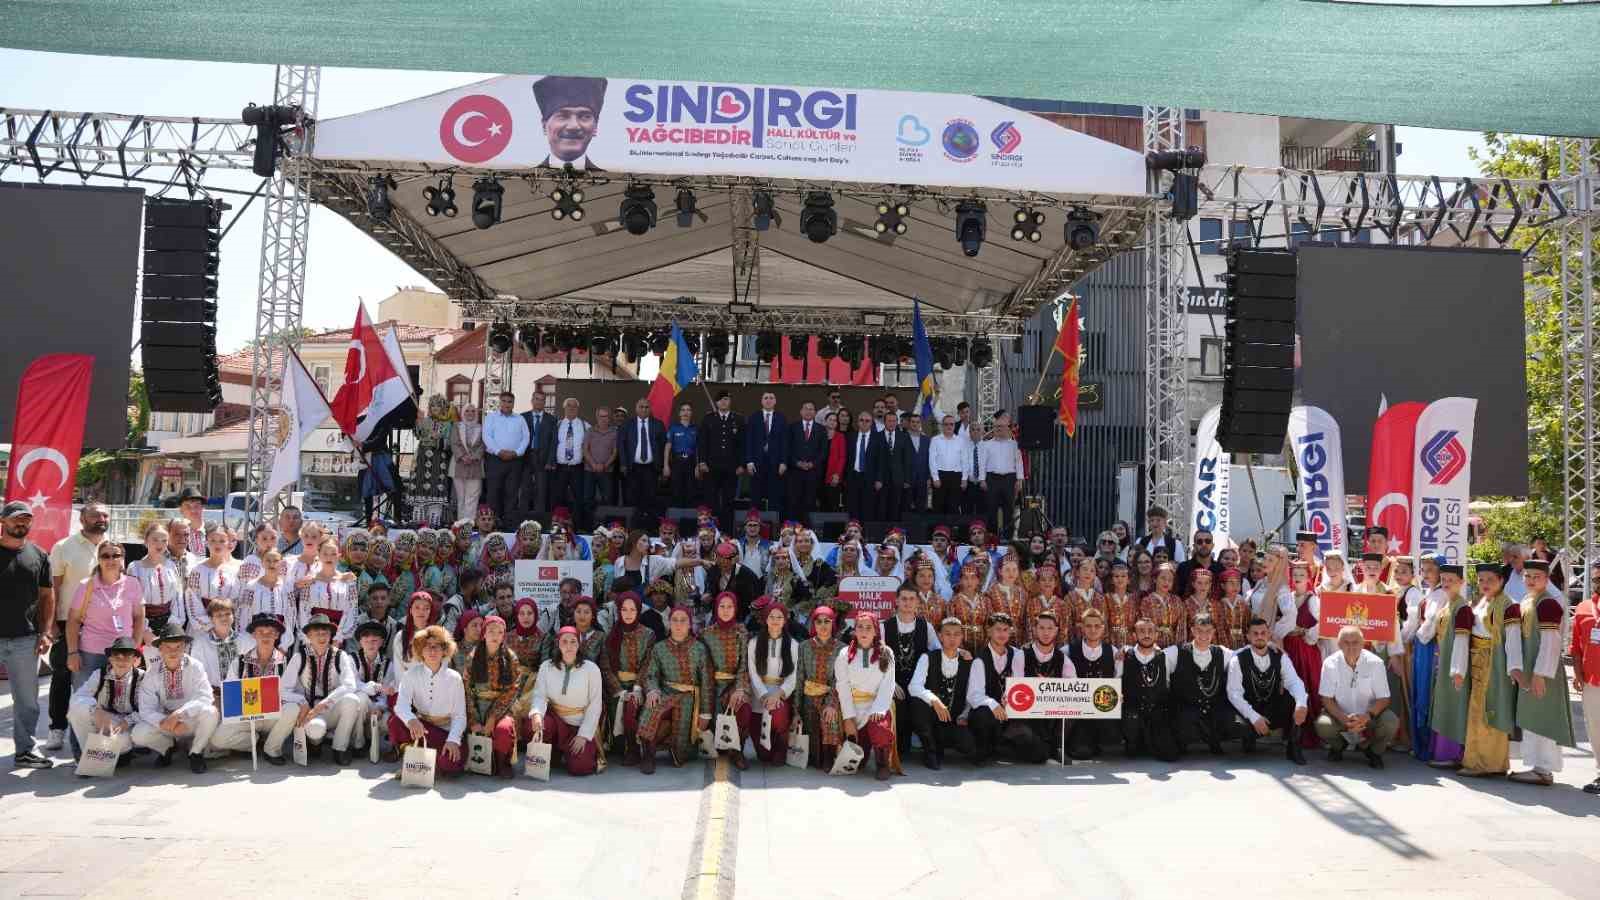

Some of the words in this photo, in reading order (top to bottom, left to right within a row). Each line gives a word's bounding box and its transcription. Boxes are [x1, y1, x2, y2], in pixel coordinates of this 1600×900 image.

[623, 84, 857, 148] SINDIRGI
[626, 124, 750, 146] YAĞCIBEDİR
[797, 127, 841, 141] KÜLTÜR
[1419, 496, 1440, 555] IRGI
[1442, 497, 1462, 565] DİYESİ
[859, 592, 882, 600] HALK
[1327, 616, 1388, 627] MONTENEGRO
[1039, 681, 1089, 694] ÇATALAĞZI
